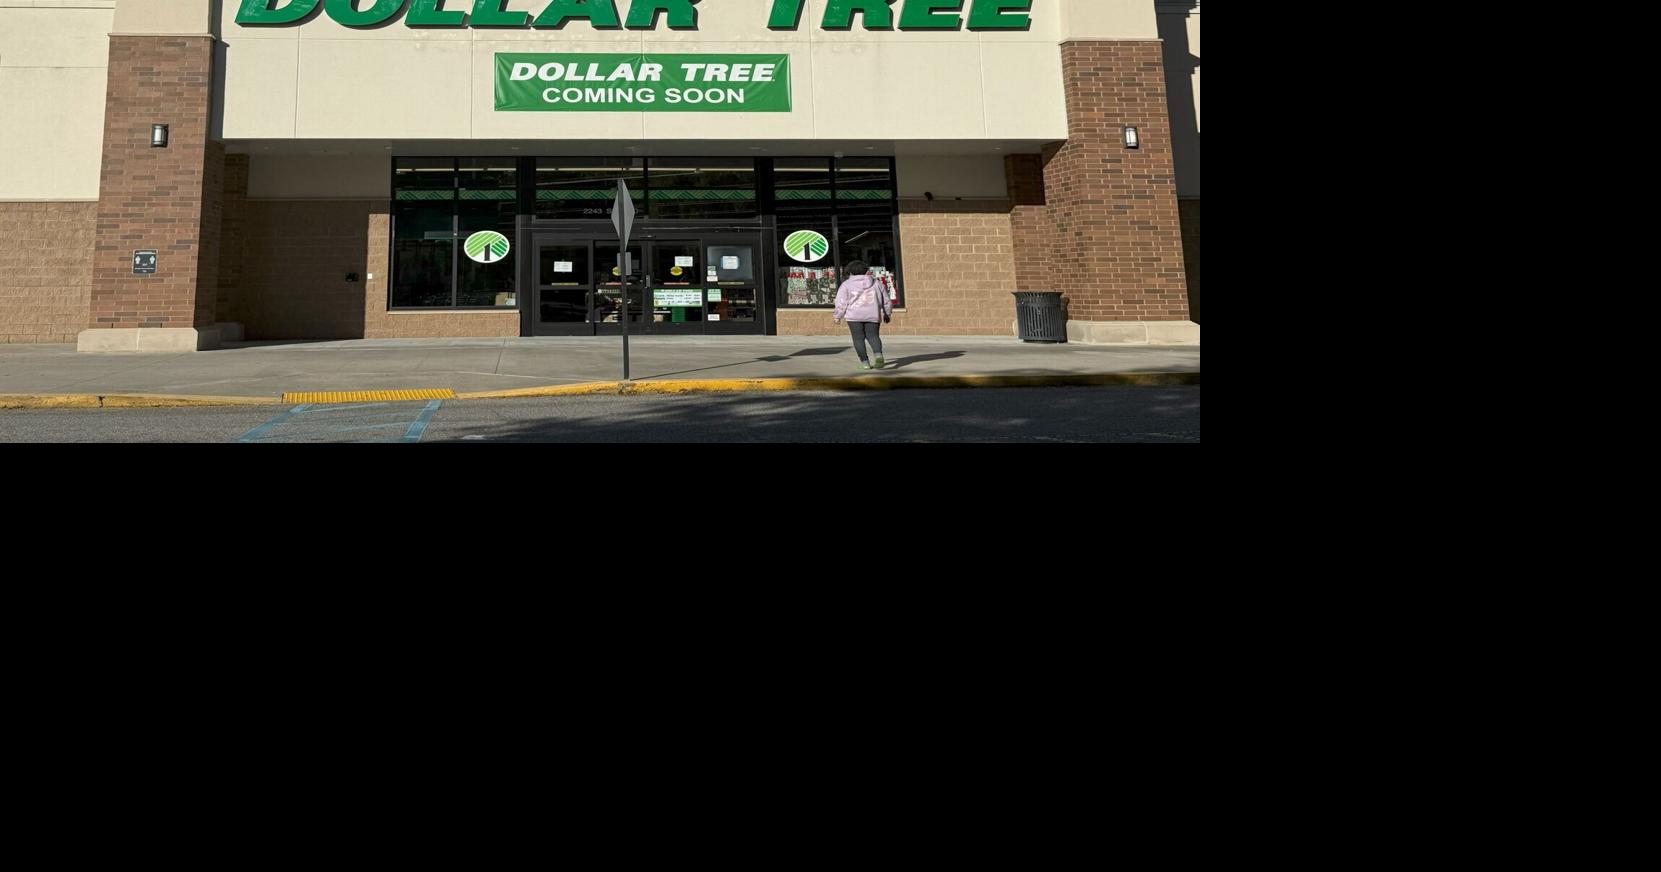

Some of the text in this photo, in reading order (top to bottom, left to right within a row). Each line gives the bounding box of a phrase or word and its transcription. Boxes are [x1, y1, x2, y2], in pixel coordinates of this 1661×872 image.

[509, 62, 775, 82] DOLLAR TREE
[542, 87, 745, 103] COMING SOON
